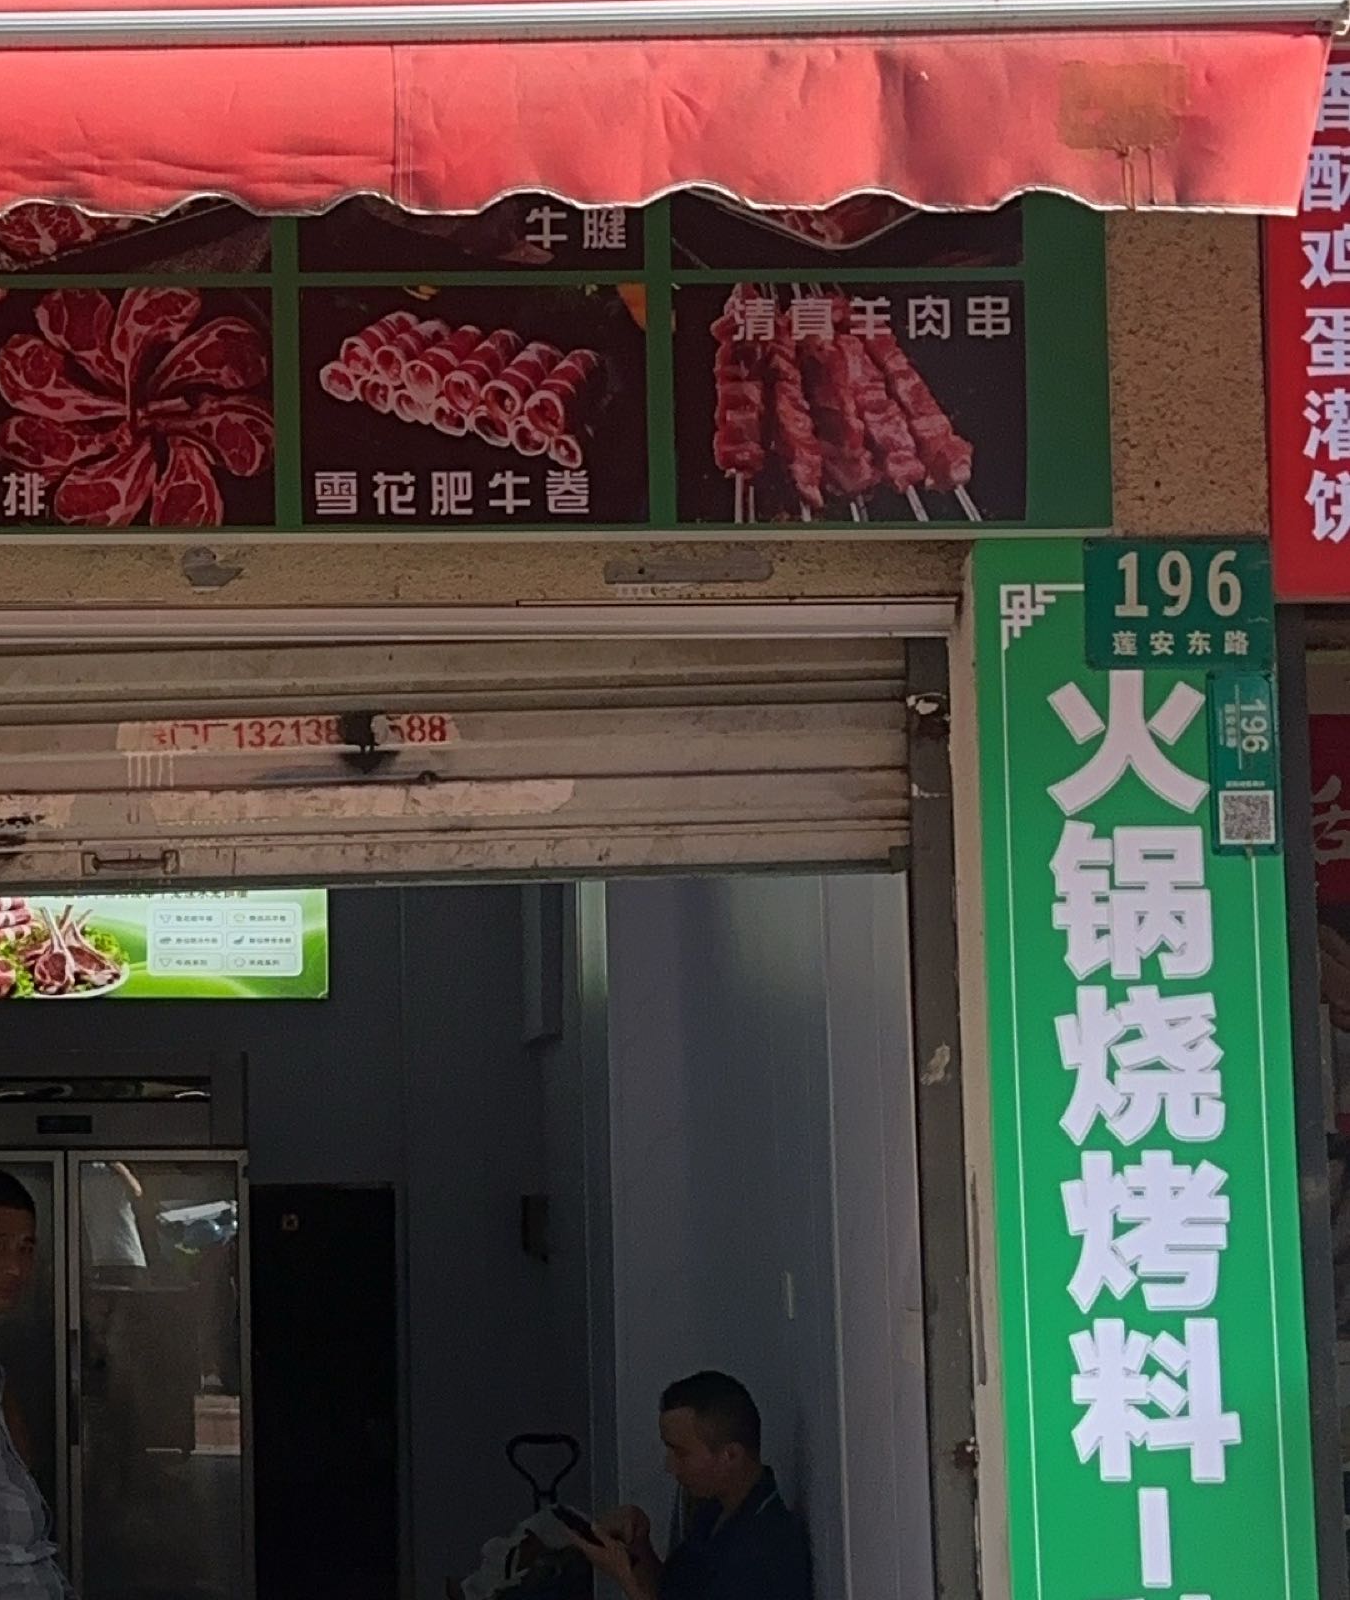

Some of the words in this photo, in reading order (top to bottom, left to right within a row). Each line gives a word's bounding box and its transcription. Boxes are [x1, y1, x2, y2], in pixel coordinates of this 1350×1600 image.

[525, 205, 626, 249] 牛腱
[732, 295, 1011, 341] 清真羊肉串
[314, 470, 590, 515] 雪花肥牛卷
[1114, 550, 1243, 618] 196
[1112, 630, 1250, 656] 莲安东路
[1240, 699, 1270, 753] 196
